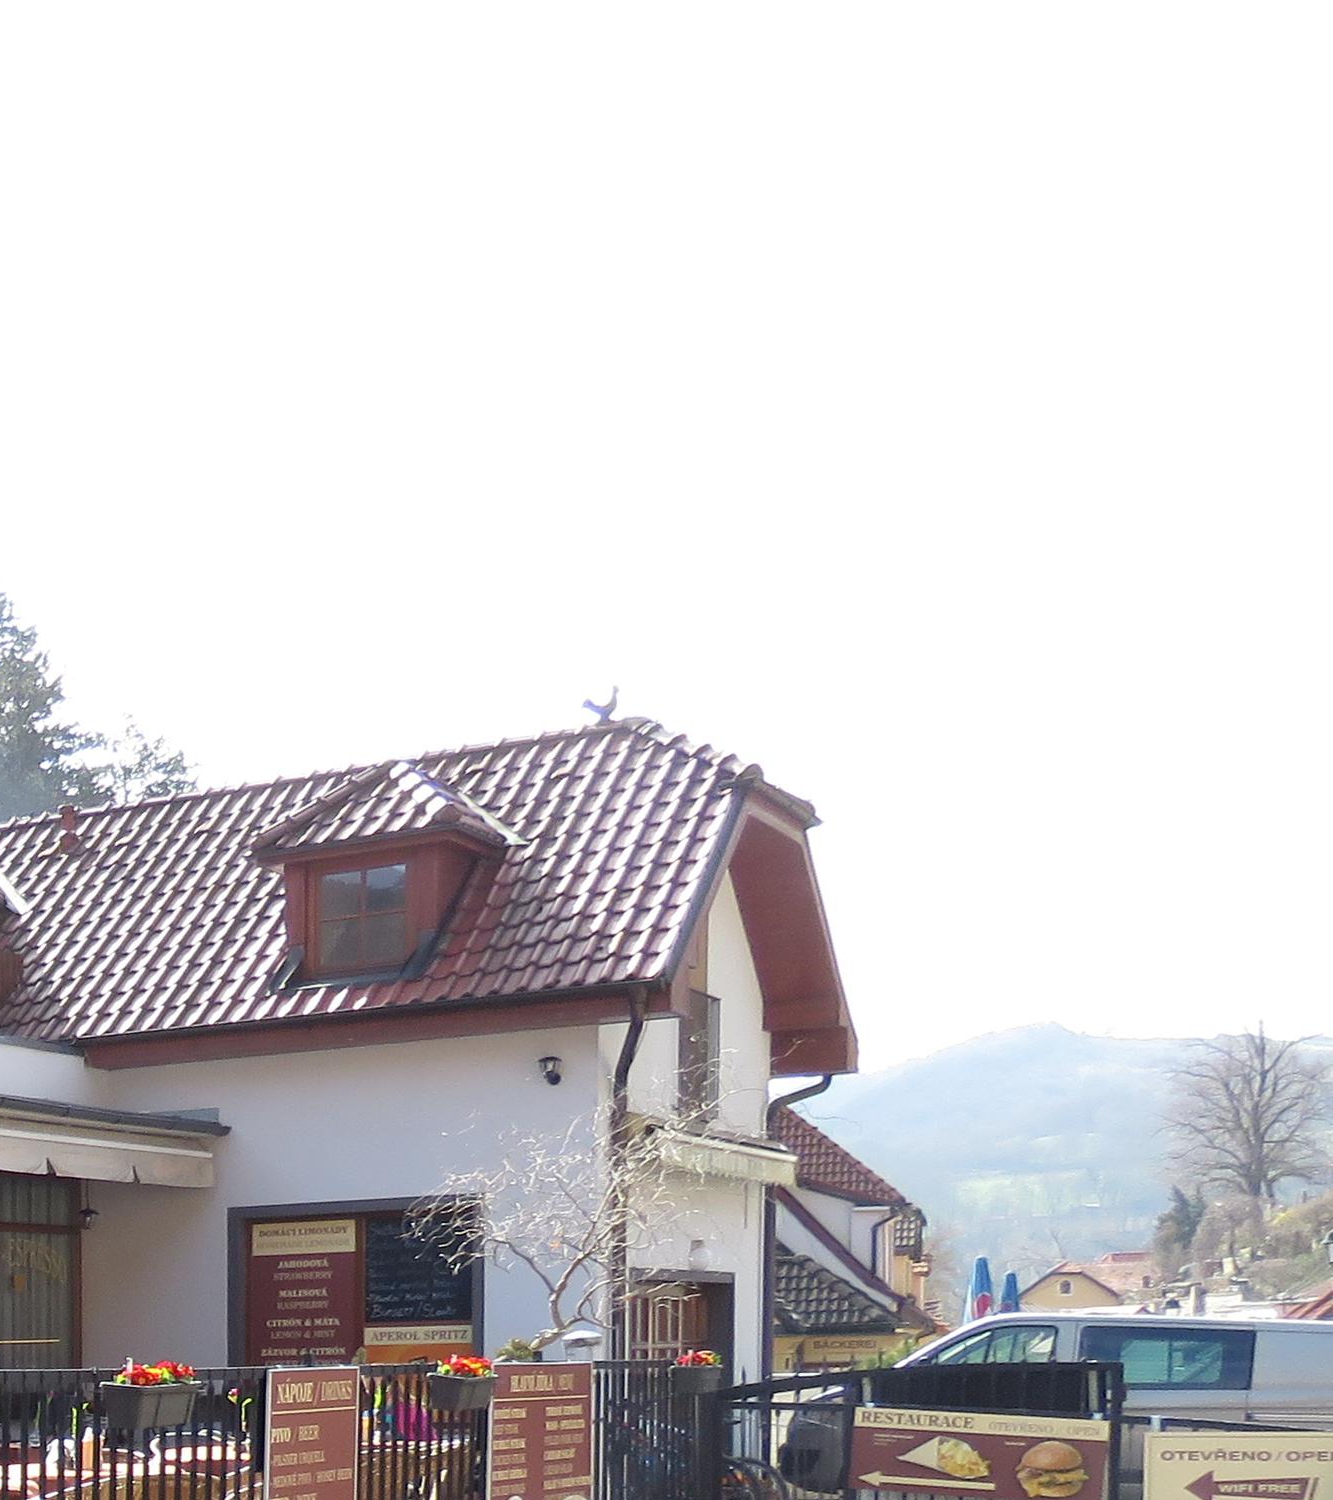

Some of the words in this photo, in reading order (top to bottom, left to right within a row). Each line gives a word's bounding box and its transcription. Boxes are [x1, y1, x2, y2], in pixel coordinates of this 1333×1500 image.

[277, 1258, 329, 1269] JAHODOVÁ
[273, 1271, 332, 1281] STRAWBERRY
[371, 1330, 421, 1342] APEROL
[423, 1329, 468, 1340] SPRITZ
[277, 1378, 314, 1404] NÁPOJE
[320, 1380, 353, 1401] DRINKS
[861, 1410, 974, 1430] RESTAURACE
[271, 1427, 292, 1443] PIVO
[1161, 1448, 1272, 1462] OTEVŘENO
[1274, 1451, 1282, 1462] /
[1219, 1483, 1252, 1493] WIFI
[1257, 1483, 1302, 1494] FREE
